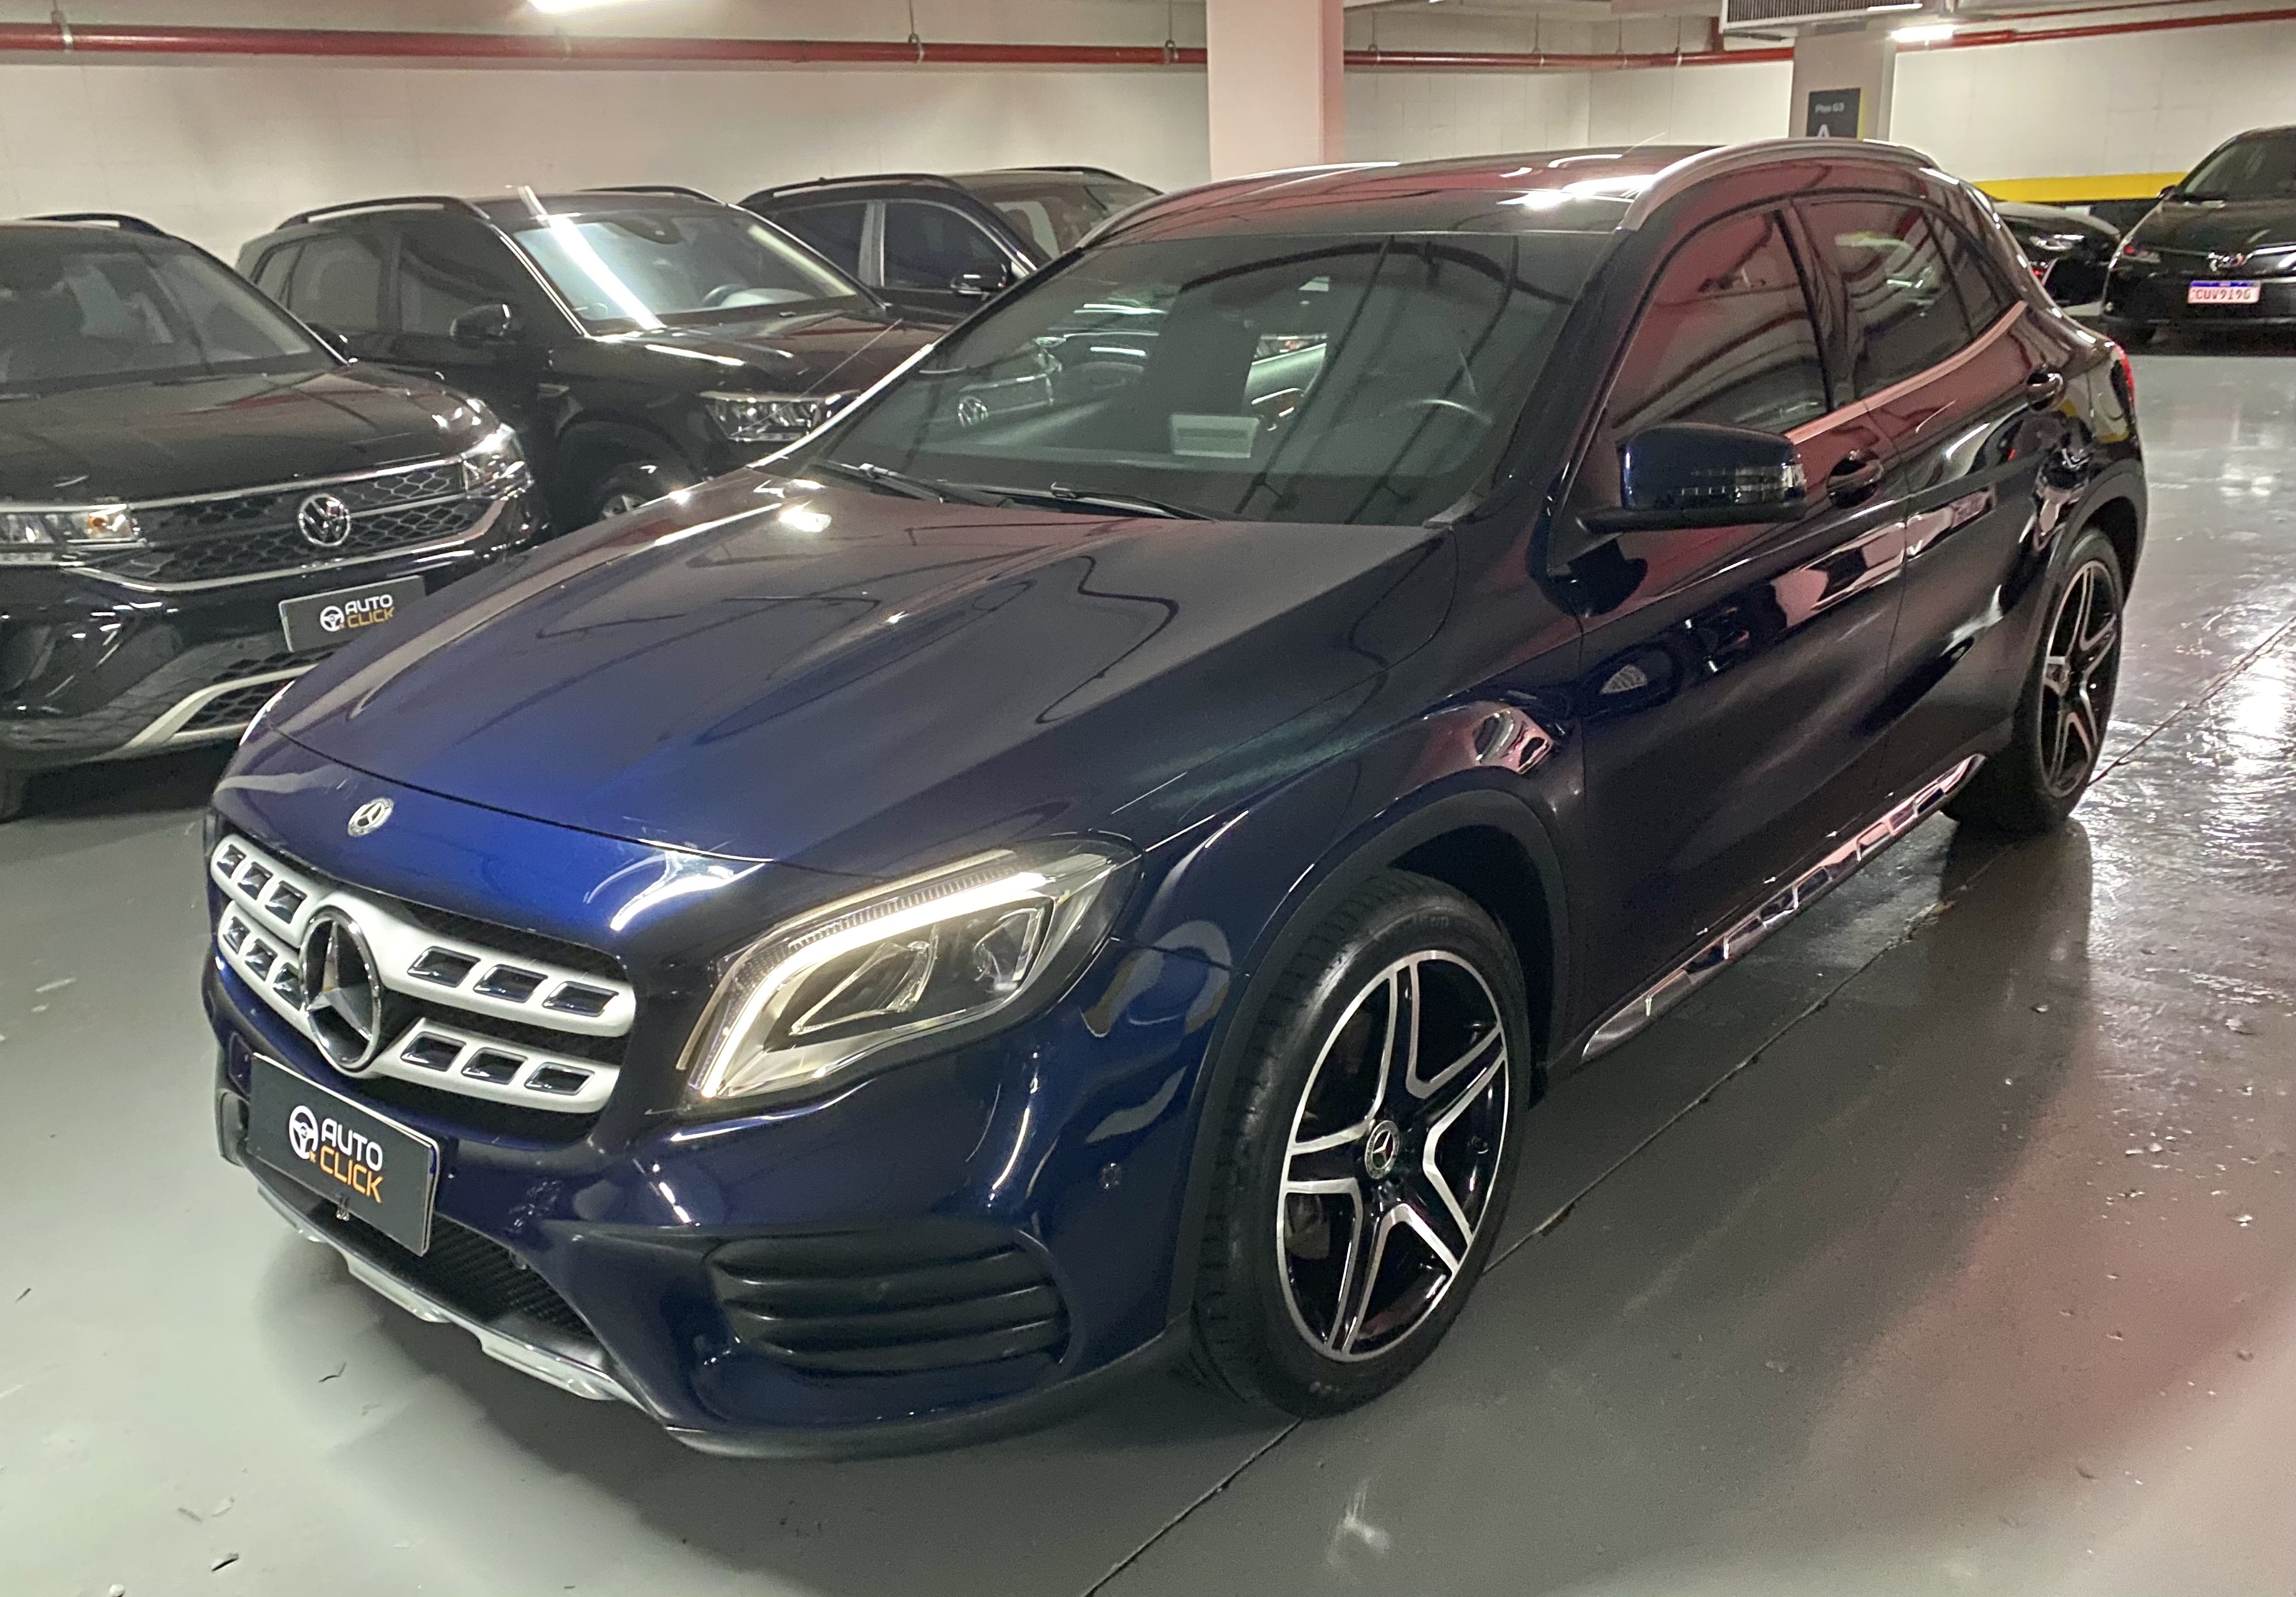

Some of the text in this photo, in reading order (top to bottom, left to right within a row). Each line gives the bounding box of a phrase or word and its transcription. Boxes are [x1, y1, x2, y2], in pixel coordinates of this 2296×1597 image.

[345, 594, 393, 615] AUTO
[347, 607, 394, 629] CLICK
[321, 1118, 383, 1171] AUTO
[320, 1145, 384, 1203] CLICK
